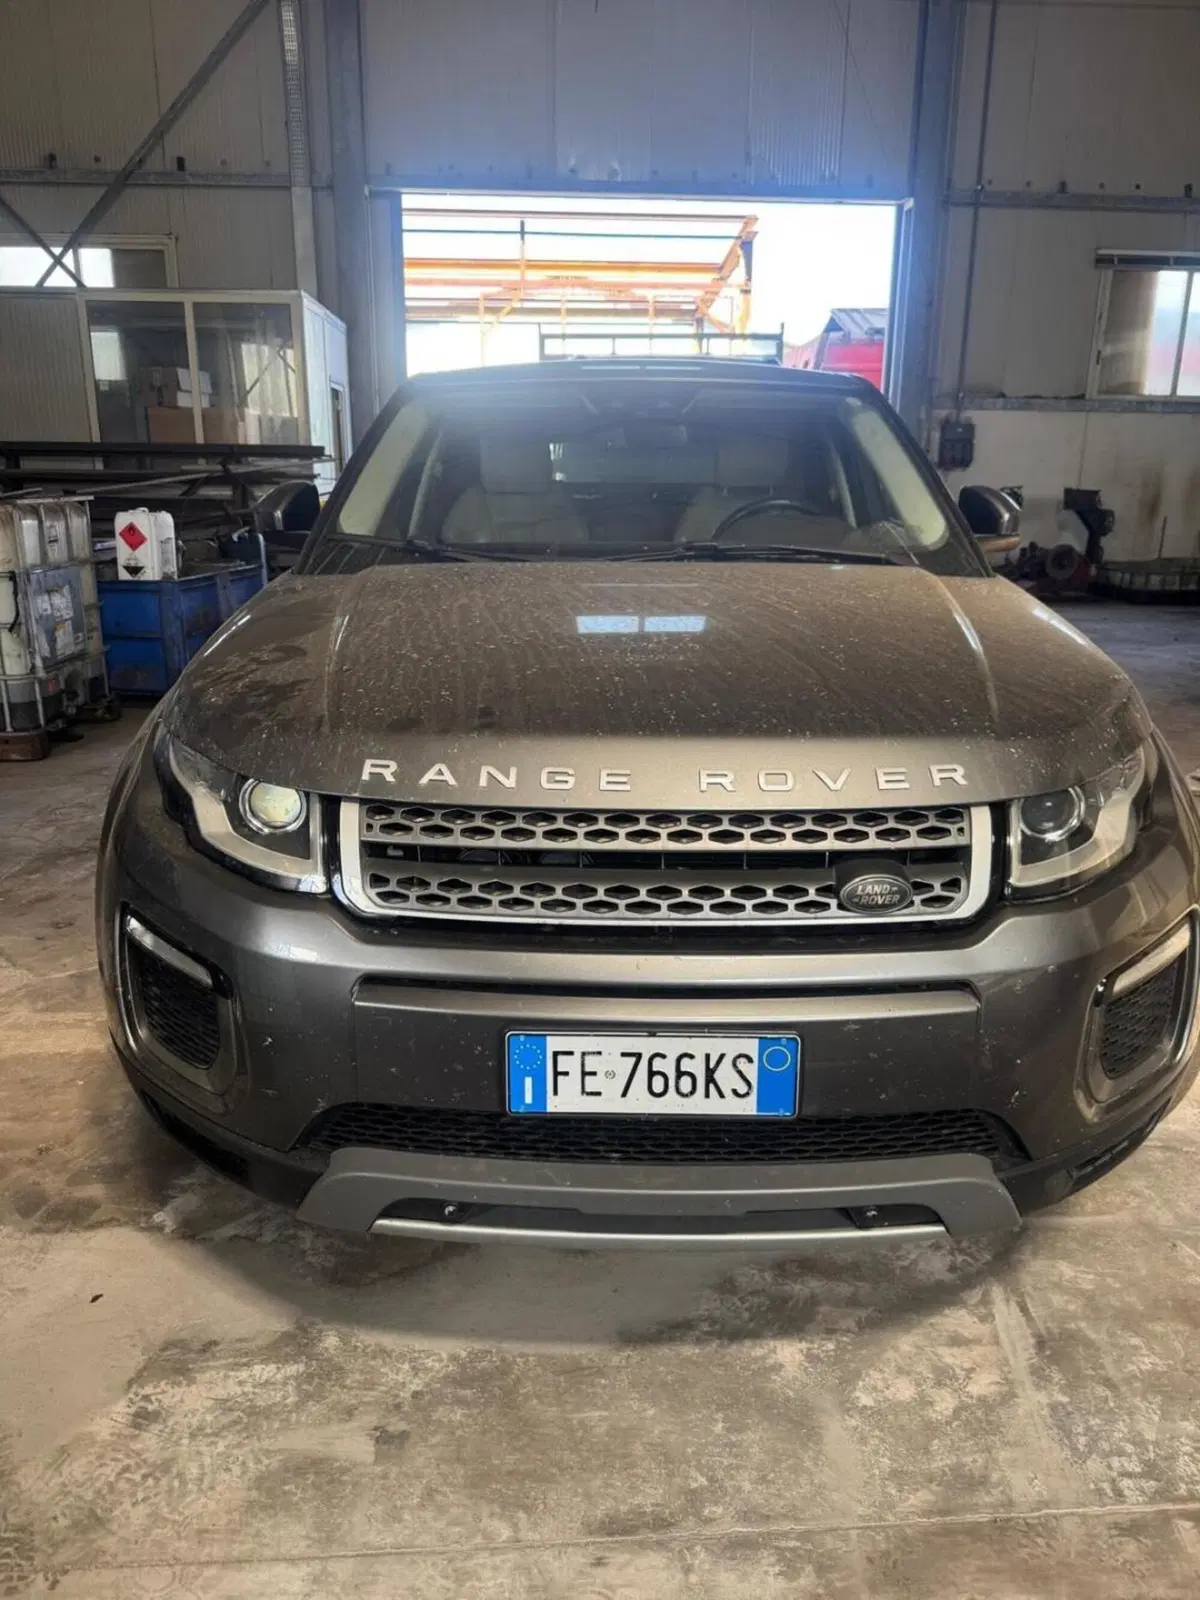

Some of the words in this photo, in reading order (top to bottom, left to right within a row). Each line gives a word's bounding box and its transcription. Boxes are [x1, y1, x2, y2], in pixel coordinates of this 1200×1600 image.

[361, 758, 632, 792] RANGE
[699, 763, 969, 793] ROVER
[856, 883, 891, 895] LAND
[859, 894, 901, 905] ROVER
